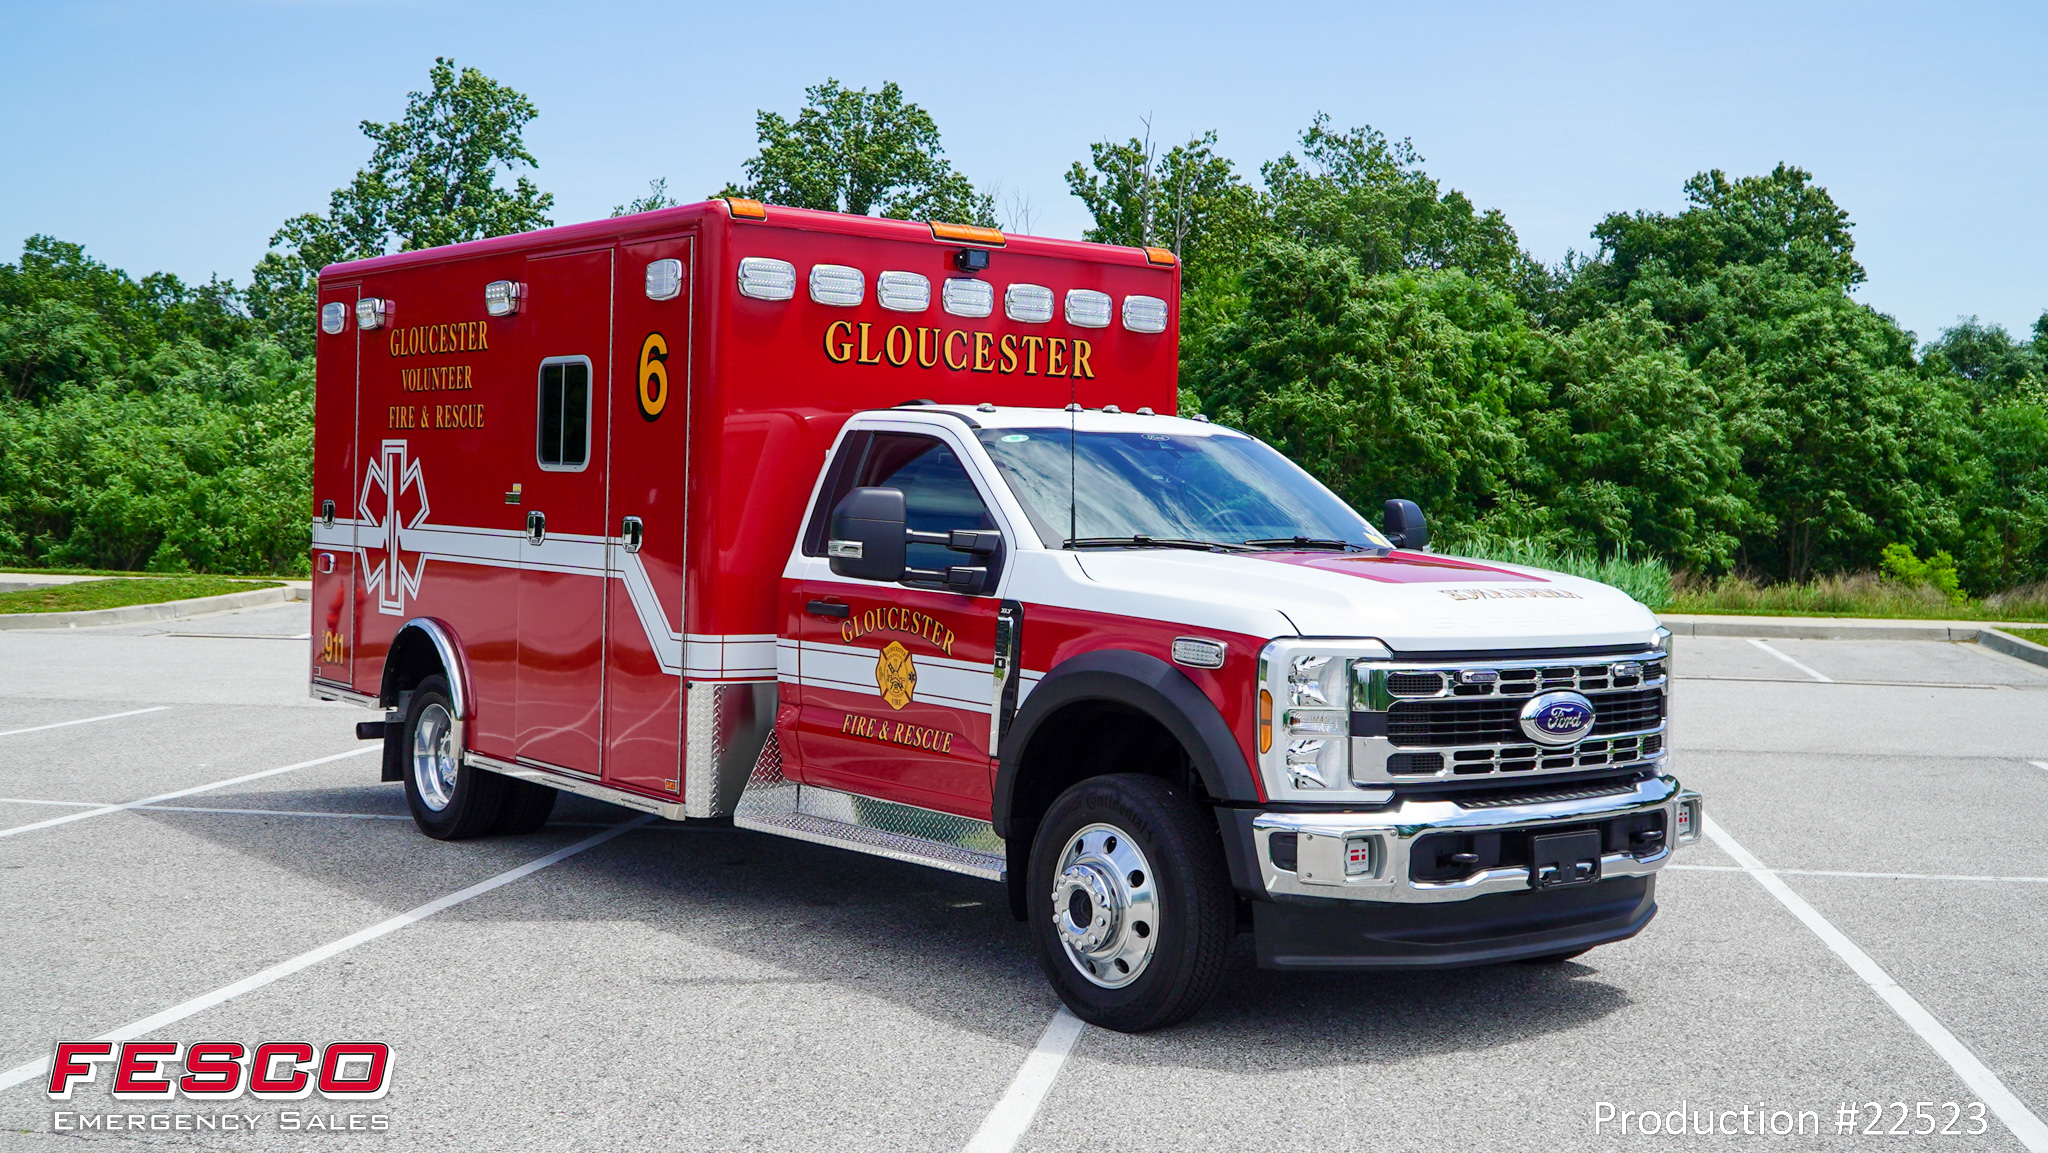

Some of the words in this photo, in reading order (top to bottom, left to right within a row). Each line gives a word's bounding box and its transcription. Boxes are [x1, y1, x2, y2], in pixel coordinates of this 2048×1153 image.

[389, 320, 489, 358] GLOUCESTER
[823, 320, 1096, 380] GLOUCESTER
[401, 365, 473, 392] VOLUNTEER
[636, 331, 669, 422] 6
[388, 406, 416, 429] FIRE
[420, 405, 430, 429] &
[435, 404, 485, 429] RESCUE
[325, 630, 345, 666] 911
[841, 607, 955, 657] GLOUCESTER
[841, 714, 877, 739] FIRE
[878, 720, 890, 742] &
[893, 722, 954, 754] RESCUE
[1547, 707, 1582, 730] Ford
